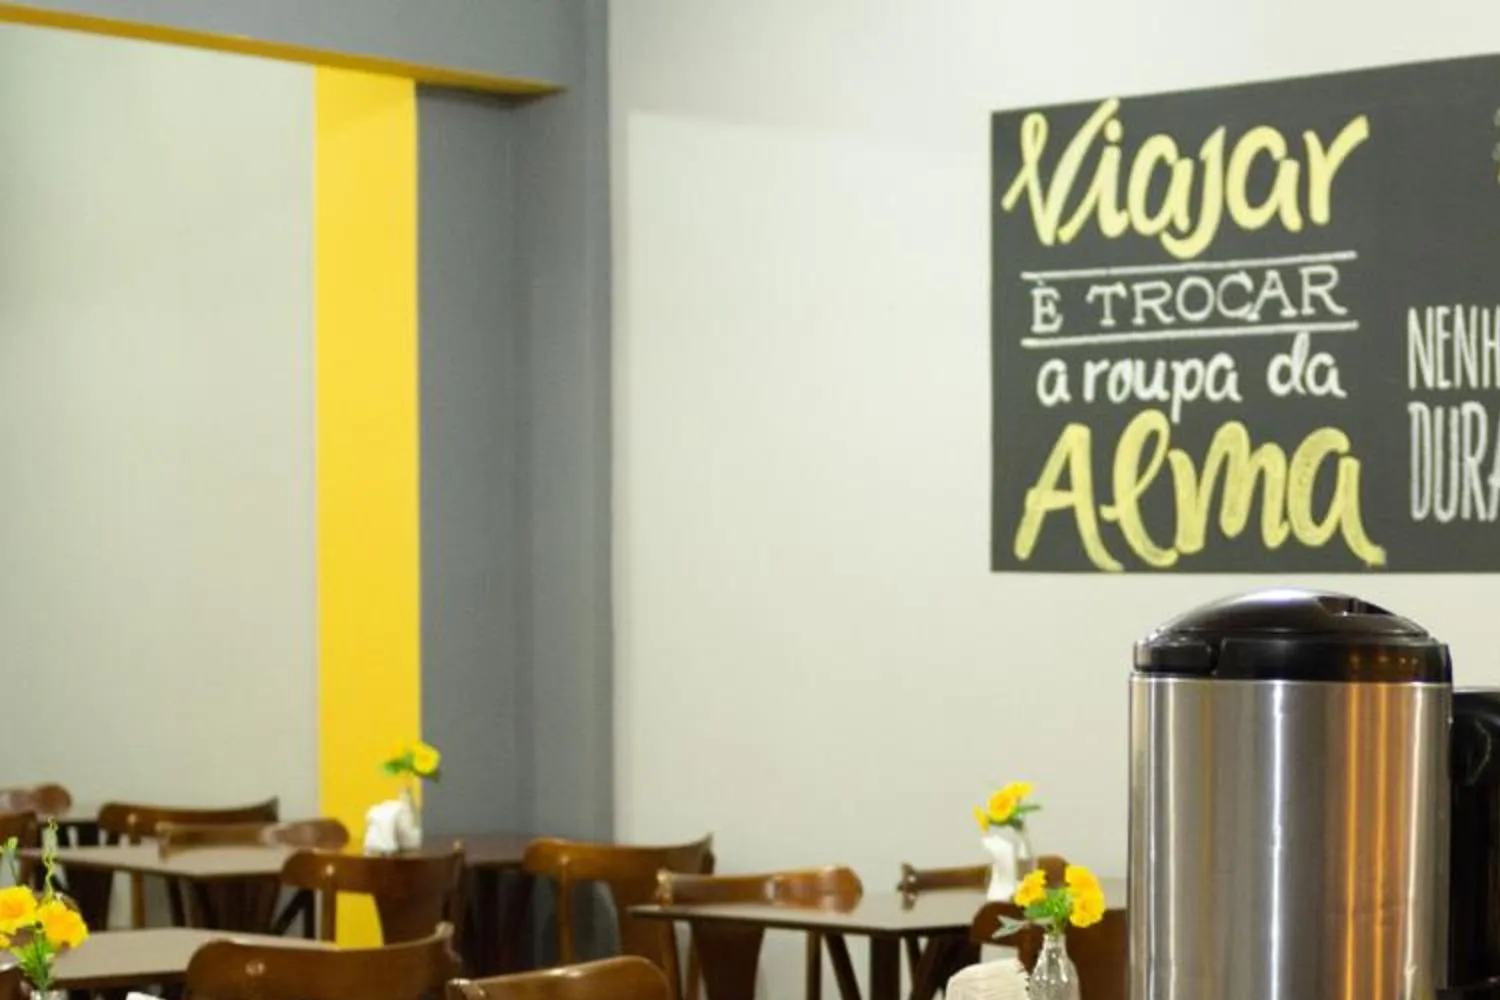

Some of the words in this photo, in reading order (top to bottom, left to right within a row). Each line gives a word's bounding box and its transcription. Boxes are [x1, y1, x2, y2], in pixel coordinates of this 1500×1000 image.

[1001, 96, 1370, 259] Viajar
[1086, 264, 1348, 326] TROCAR
[1036, 358, 1072, 407] a
[1083, 351, 1243, 424] roupa
[1266, 330, 1347, 400] da
[1014, 408, 1387, 574] Alma
